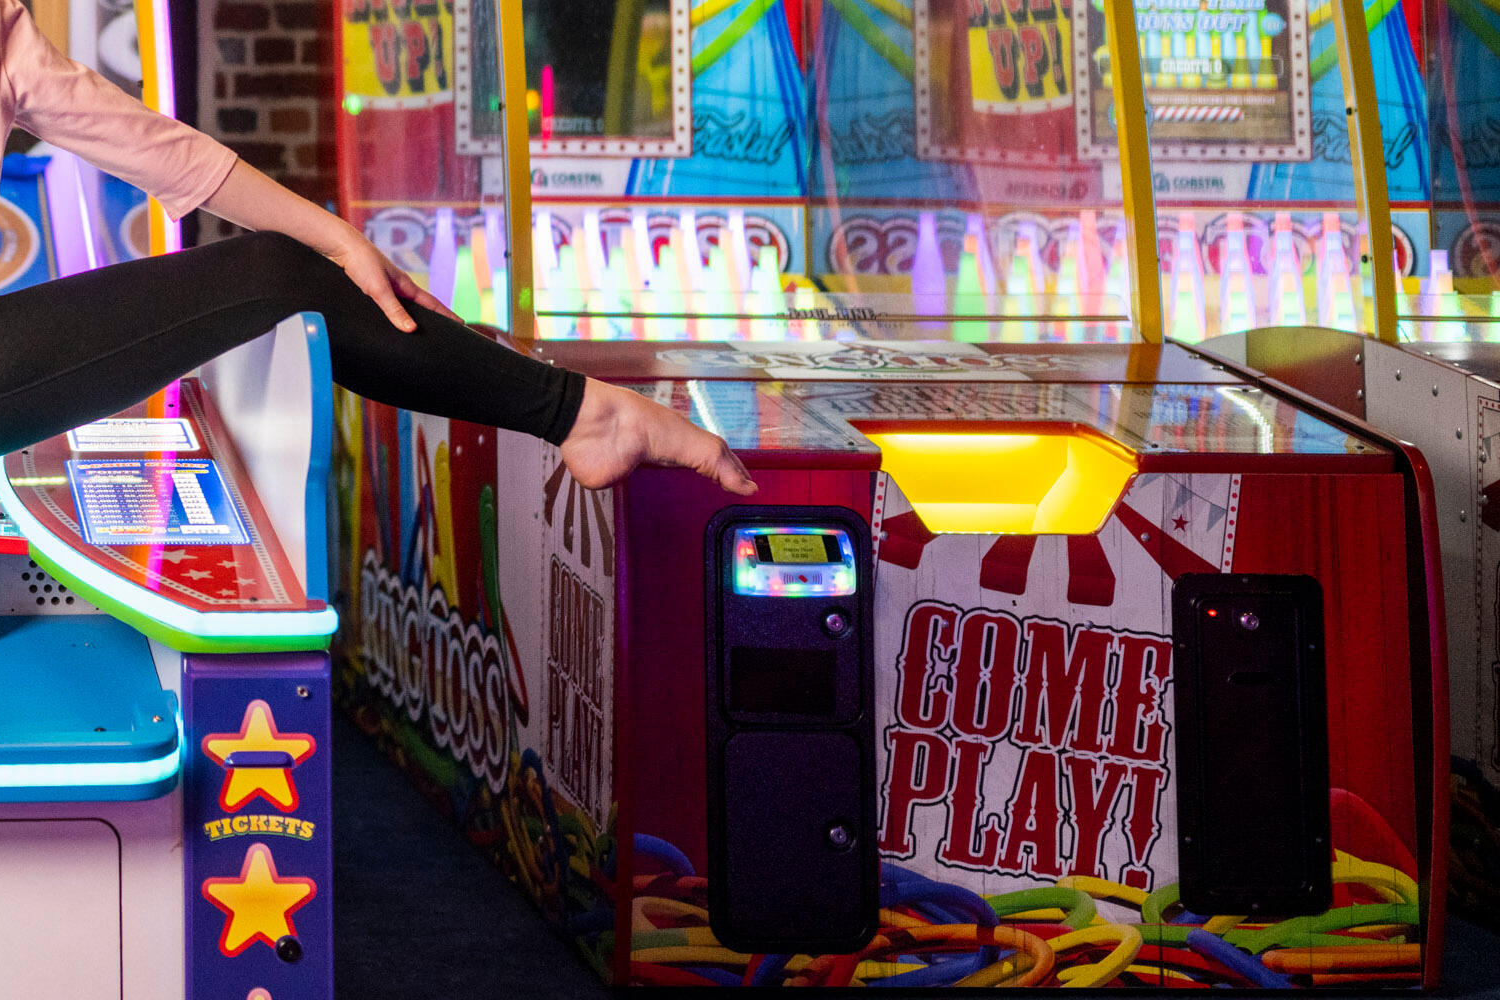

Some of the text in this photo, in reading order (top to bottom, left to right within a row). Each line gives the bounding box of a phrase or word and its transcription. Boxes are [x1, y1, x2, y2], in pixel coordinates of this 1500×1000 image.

[368, 18, 447, 92] UP!
[987, 22, 1064, 92] UP!
[361, 565, 502, 768] RING TOSS
[897, 602, 1175, 764] COME
[203, 814, 316, 841] TICKETS
[878, 730, 1168, 892] PLAY!
